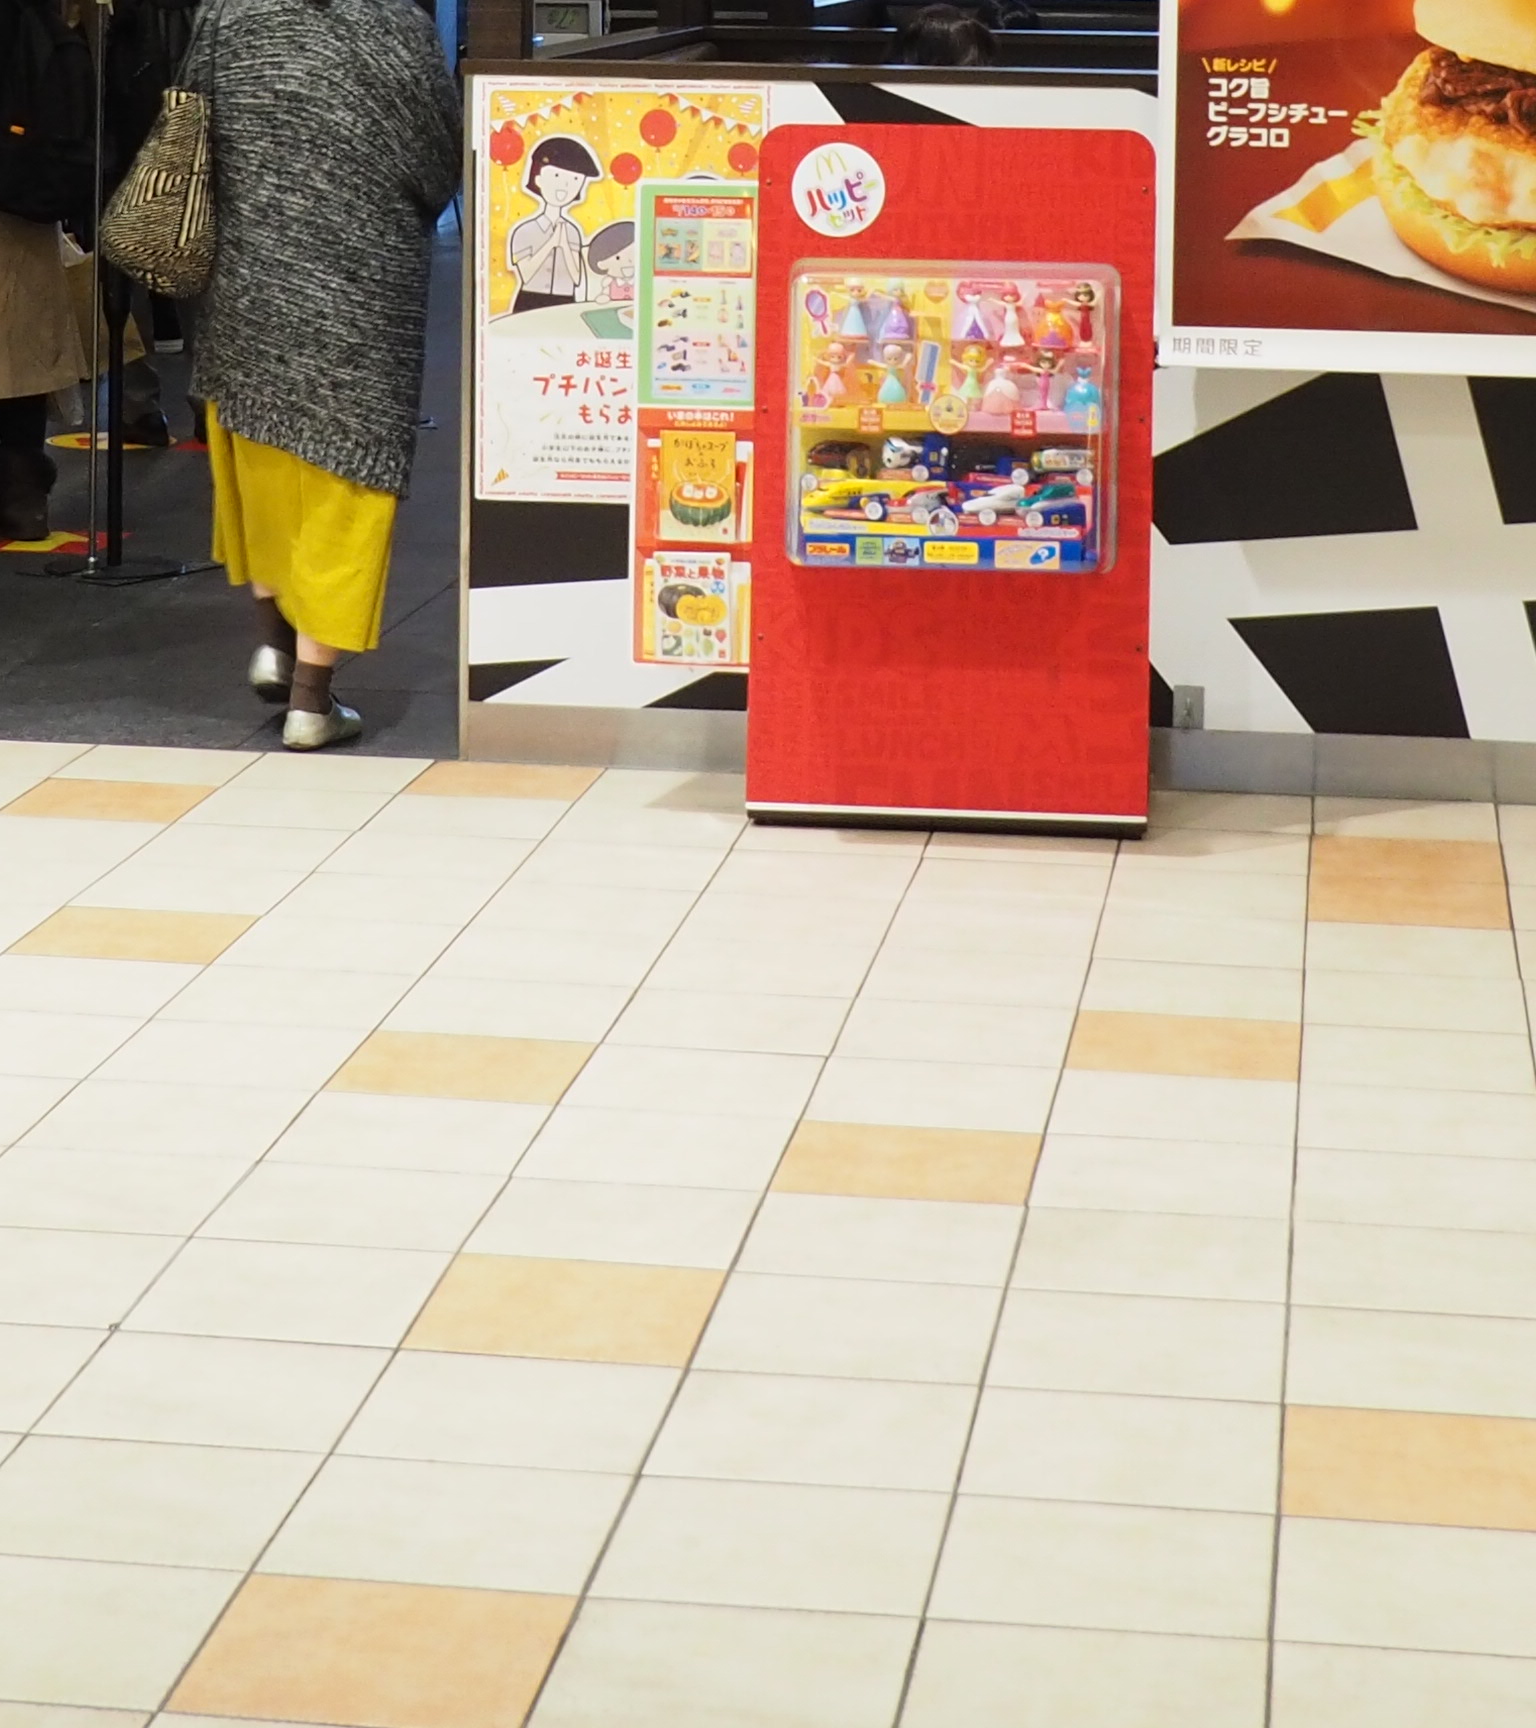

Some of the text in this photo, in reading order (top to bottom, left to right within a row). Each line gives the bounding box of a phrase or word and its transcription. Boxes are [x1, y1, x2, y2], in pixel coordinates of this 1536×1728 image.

[1208, 77, 1270, 100] コク旨
[1208, 101, 1349, 124] ビーフシチュー
[1206, 125, 1290, 148] グラコロ
[807, 170, 878, 218] ハッピー
[828, 205, 866, 229] セット
[1172, 336, 1263, 357] 期間限定
[576, 351, 633, 369] お誕生
[533, 373, 628, 397] プチパン
